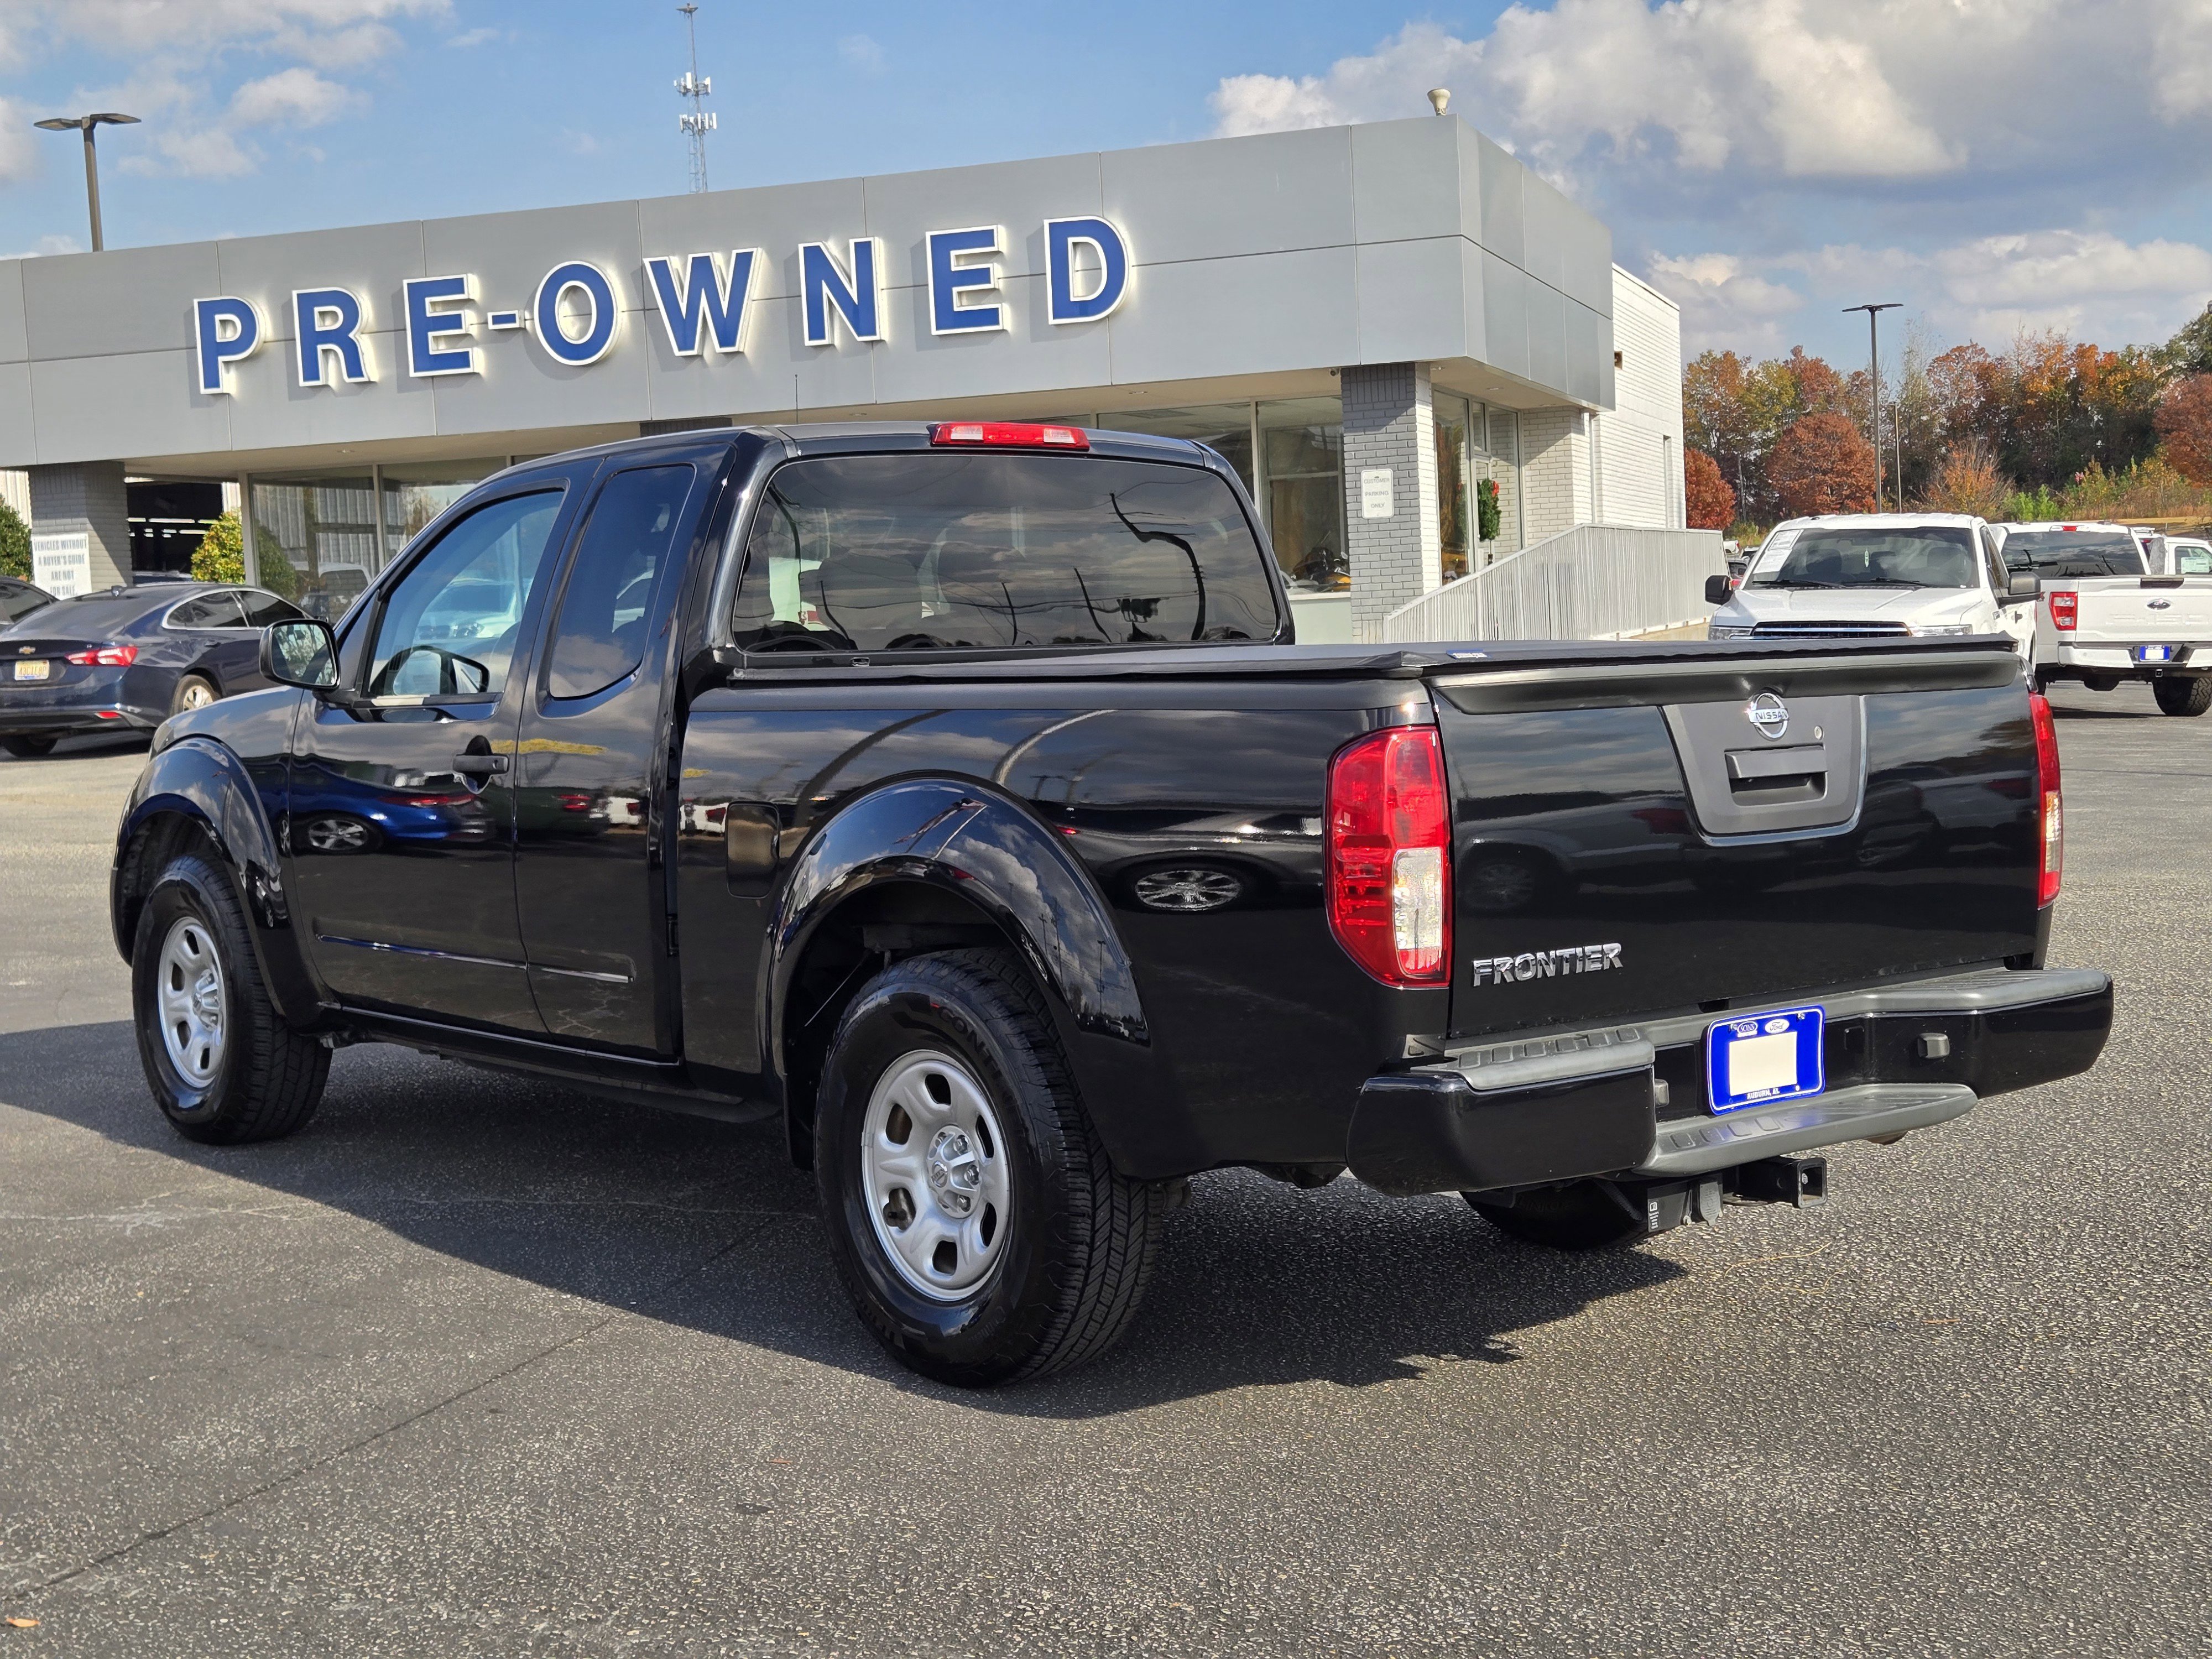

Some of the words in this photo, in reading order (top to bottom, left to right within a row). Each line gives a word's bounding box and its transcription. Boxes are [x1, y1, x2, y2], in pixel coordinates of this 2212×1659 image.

[194, 216, 1129, 394] PRE-OWNED
[34, 540, 59, 551] VEHICLES
[60, 539, 87, 550] WITHOUT
[38, 556, 42, 566] A
[43, 555, 67, 566] BUYER'S
[67, 554, 85, 565] GUIDE
[51, 571, 61, 581] ARE
[62, 570, 74, 580] NOT
[50, 586, 61, 596] FOR
[1755, 711, 1787, 720] NISSAN
[1473, 942, 1624, 987] FRONTIER
[1770, 1021, 1785, 1031] Ford
